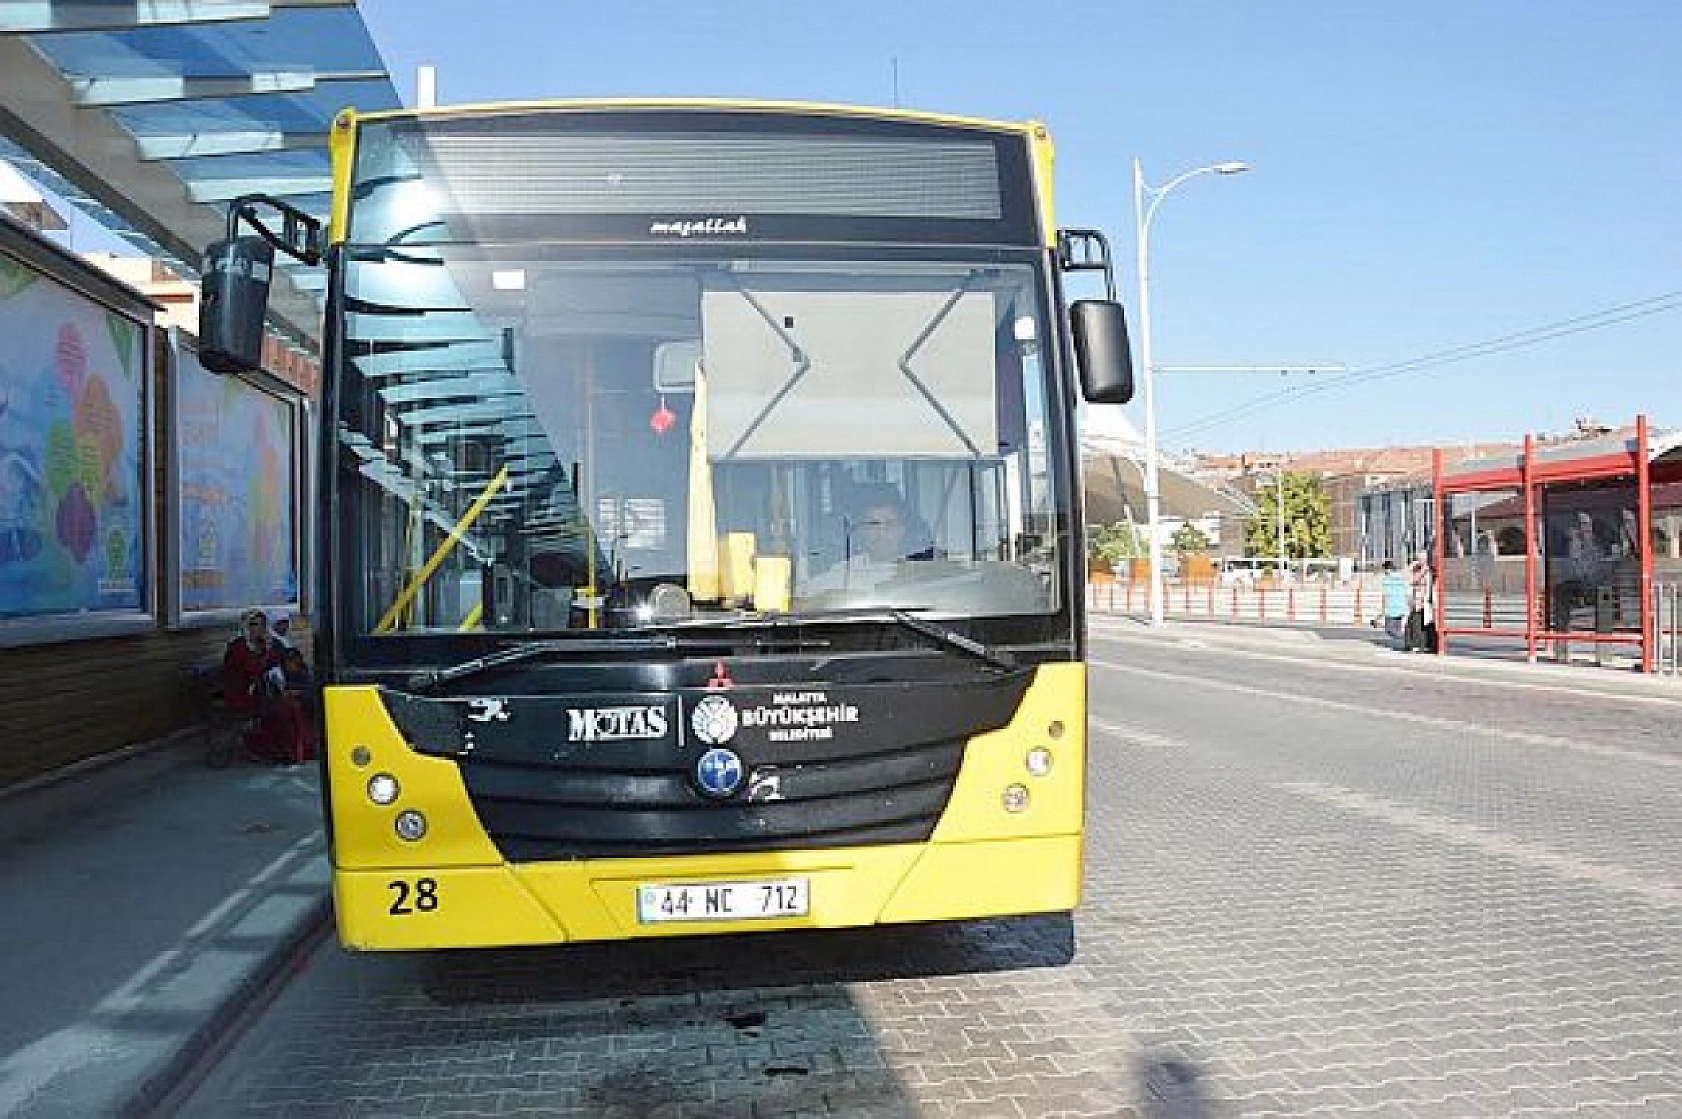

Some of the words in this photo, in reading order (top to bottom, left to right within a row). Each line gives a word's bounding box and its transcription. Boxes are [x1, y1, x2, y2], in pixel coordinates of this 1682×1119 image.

[389, 877, 438, 915] 28
[661, 888, 688, 915] 44
[706, 888, 733, 912] NC
[761, 885, 797, 912] 712
